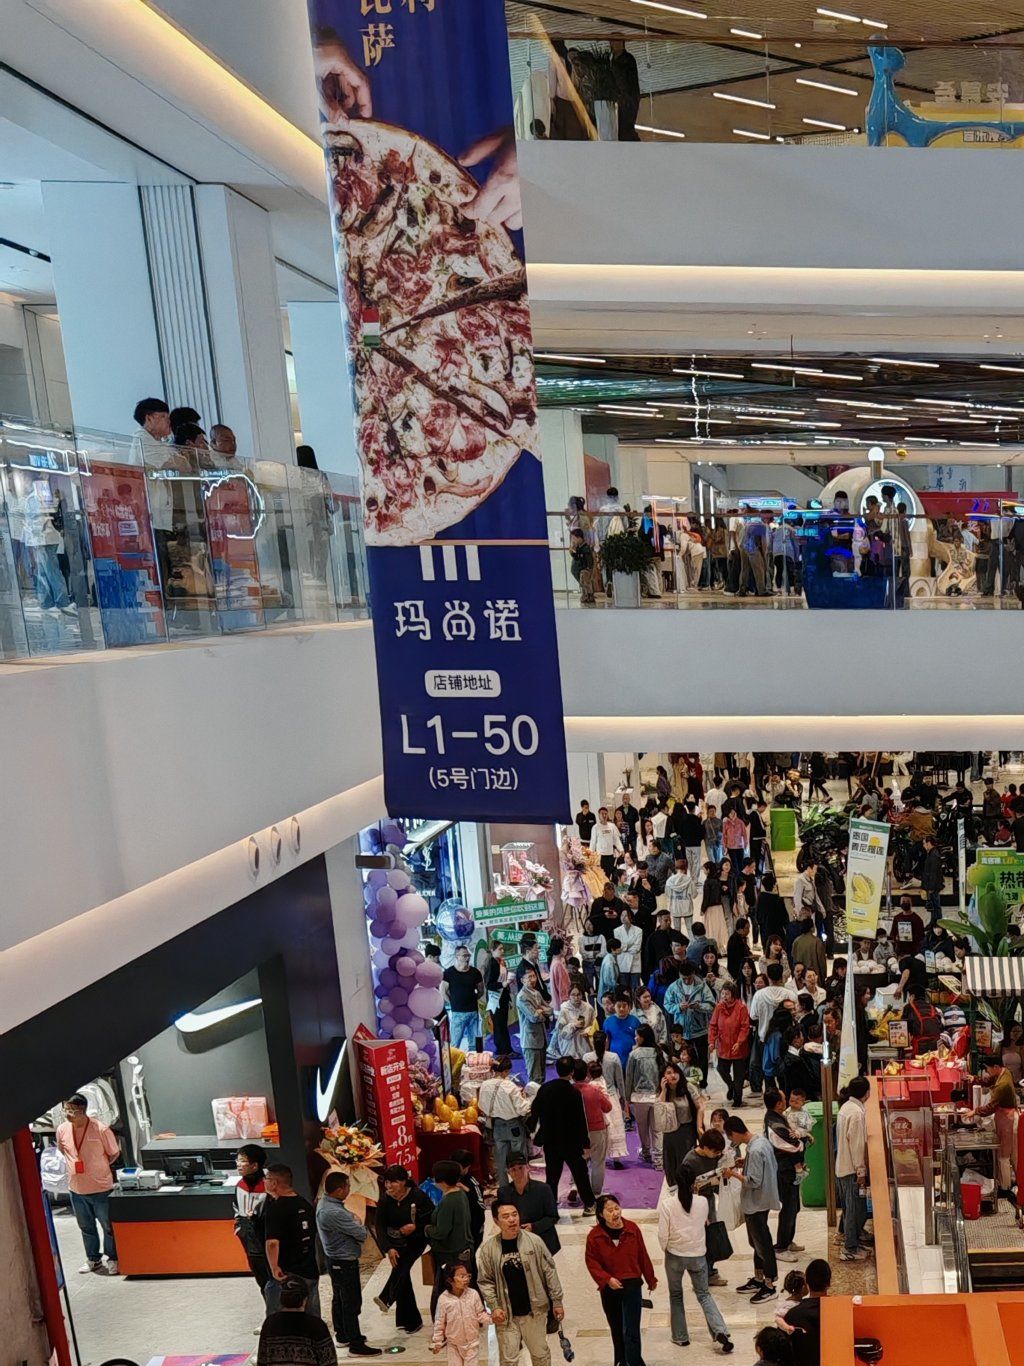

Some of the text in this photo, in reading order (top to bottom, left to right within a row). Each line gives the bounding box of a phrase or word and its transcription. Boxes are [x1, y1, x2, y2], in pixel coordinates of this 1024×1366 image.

[393, 599, 522, 641] 玛尚诺
[433, 673, 494, 692] 店铺地址
[400, 714, 540, 757] L1-50
[428, 766, 519, 791] (5号门边)
